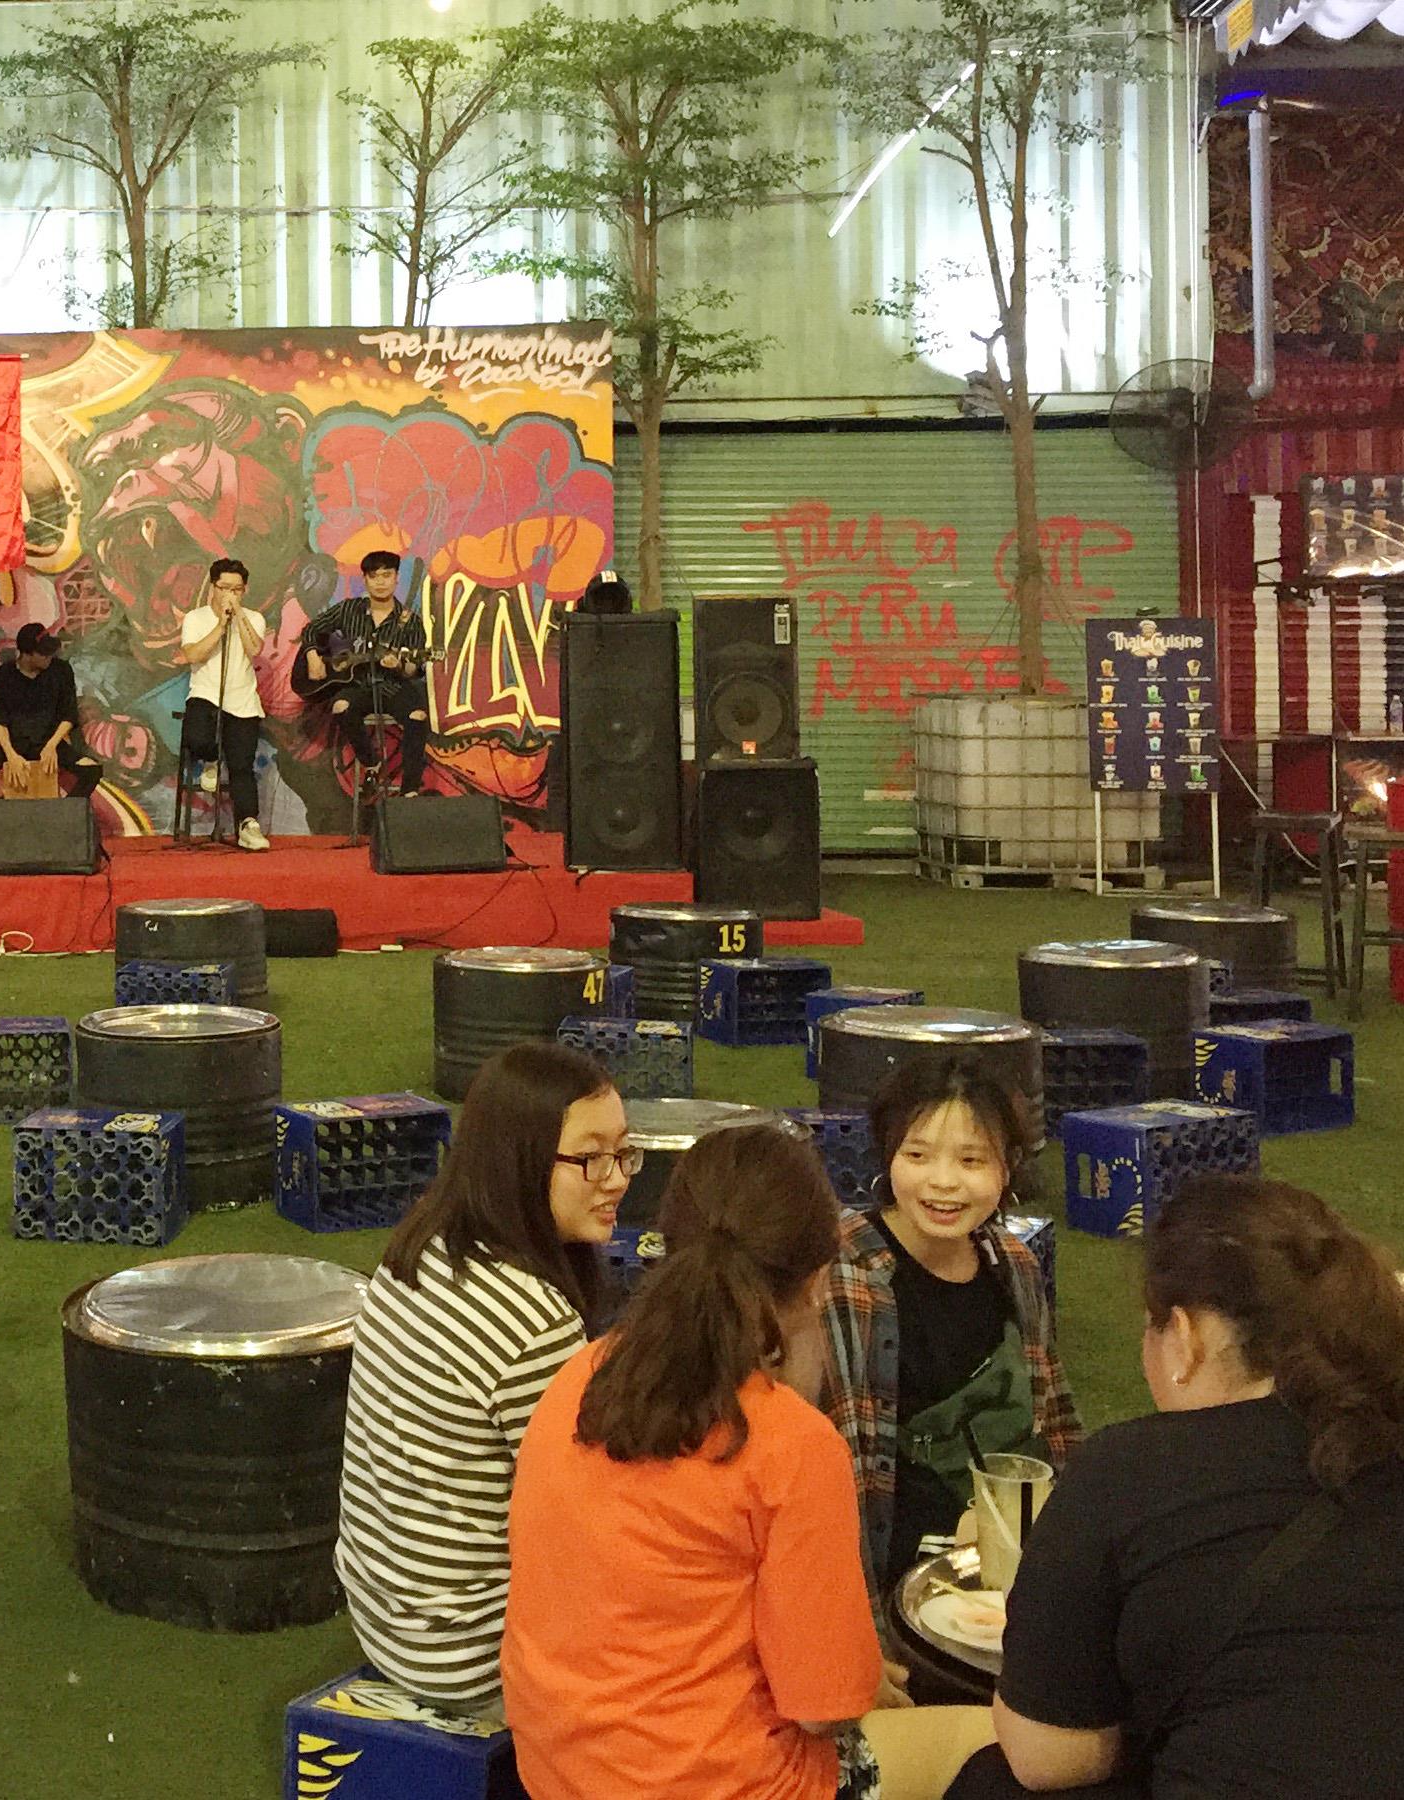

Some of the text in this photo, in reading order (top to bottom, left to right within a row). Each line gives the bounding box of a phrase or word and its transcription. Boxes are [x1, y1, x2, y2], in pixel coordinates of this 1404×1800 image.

[1107, 631, 1204, 651] Thai Cuisine
[719, 924, 746, 952] 15
[583, 969, 605, 1004] 47
